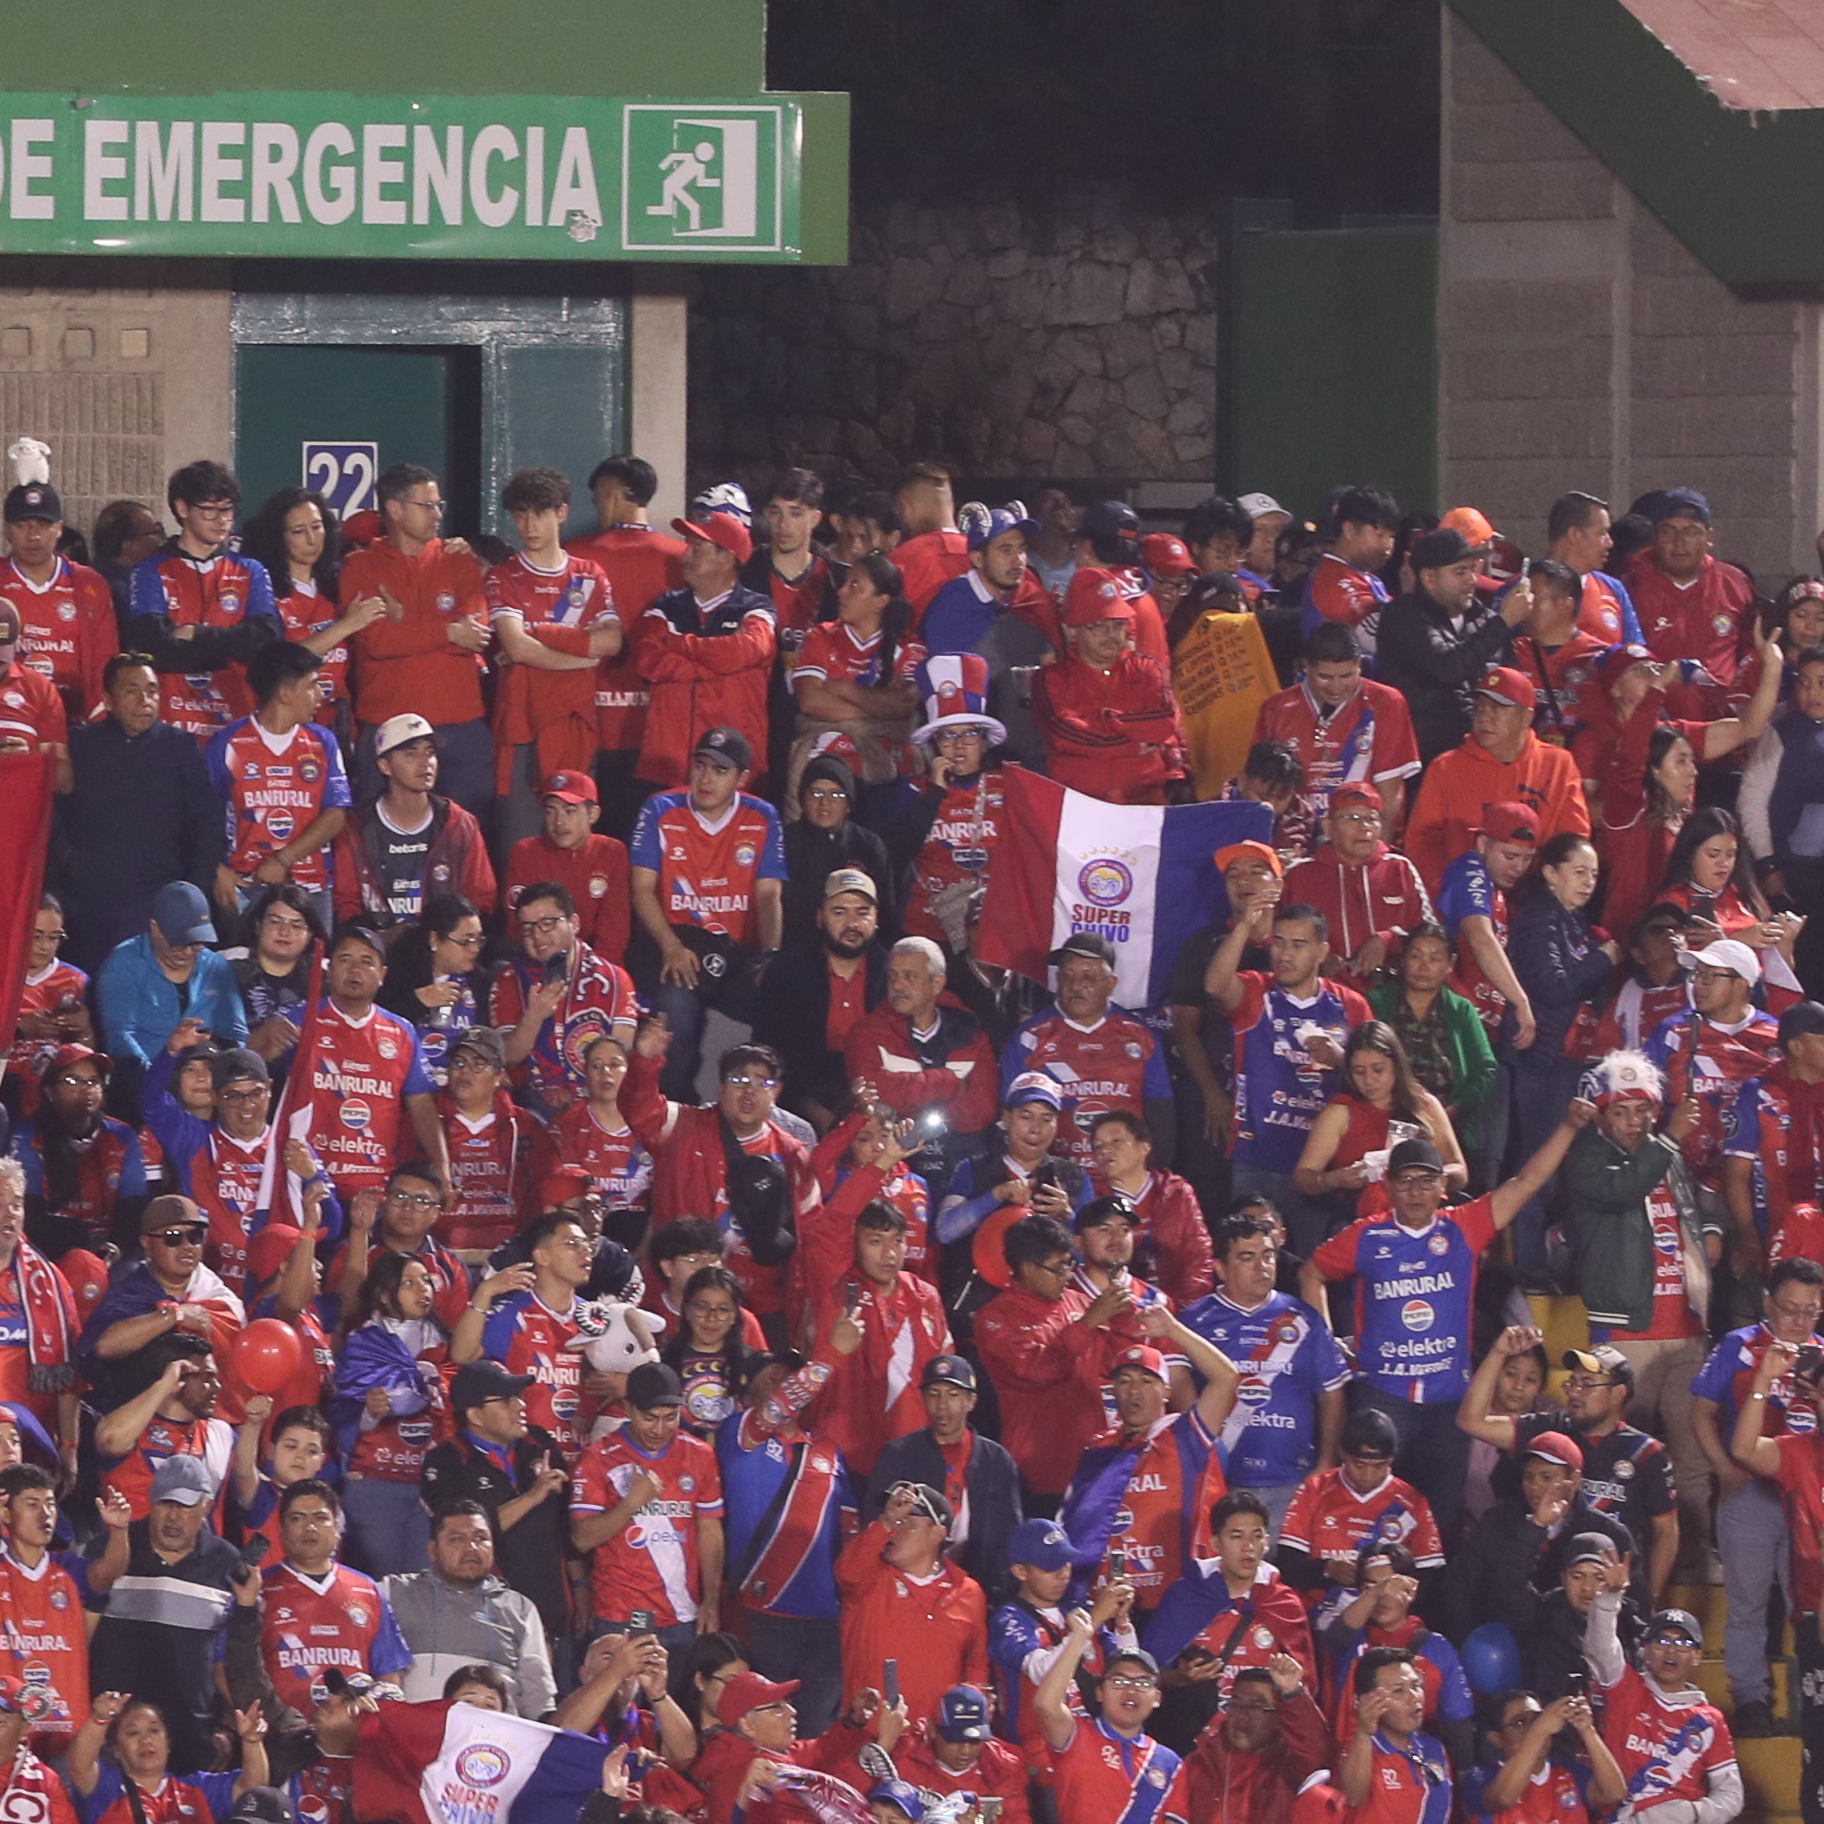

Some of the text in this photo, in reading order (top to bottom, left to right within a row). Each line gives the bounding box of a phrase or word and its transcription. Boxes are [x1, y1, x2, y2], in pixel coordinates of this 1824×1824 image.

[83, 120, 603, 228] EMERGENCIA
[308, 452, 375, 520] 22
[243, 790, 313, 808] BANRURAL
[390, 842, 428, 854] betcris
[670, 892, 749, 911] BANRURAL
[1071, 906, 1132, 924] SUPER
[312, 1073, 395, 1100] BANRURAL
[346, 1107, 371, 1120] PEPSI
[328, 1134, 386, 1158] elektra
[1374, 1275, 1455, 1300] BANRURAL
[1403, 1306, 1433, 1320] PEPSI
[1395, 1336, 1458, 1360] elektra
[1238, 1384, 1269, 1397] PEPSI
[1244, 1410, 1296, 1430] elektra
[278, 1647, 364, 1672] BANRURA
